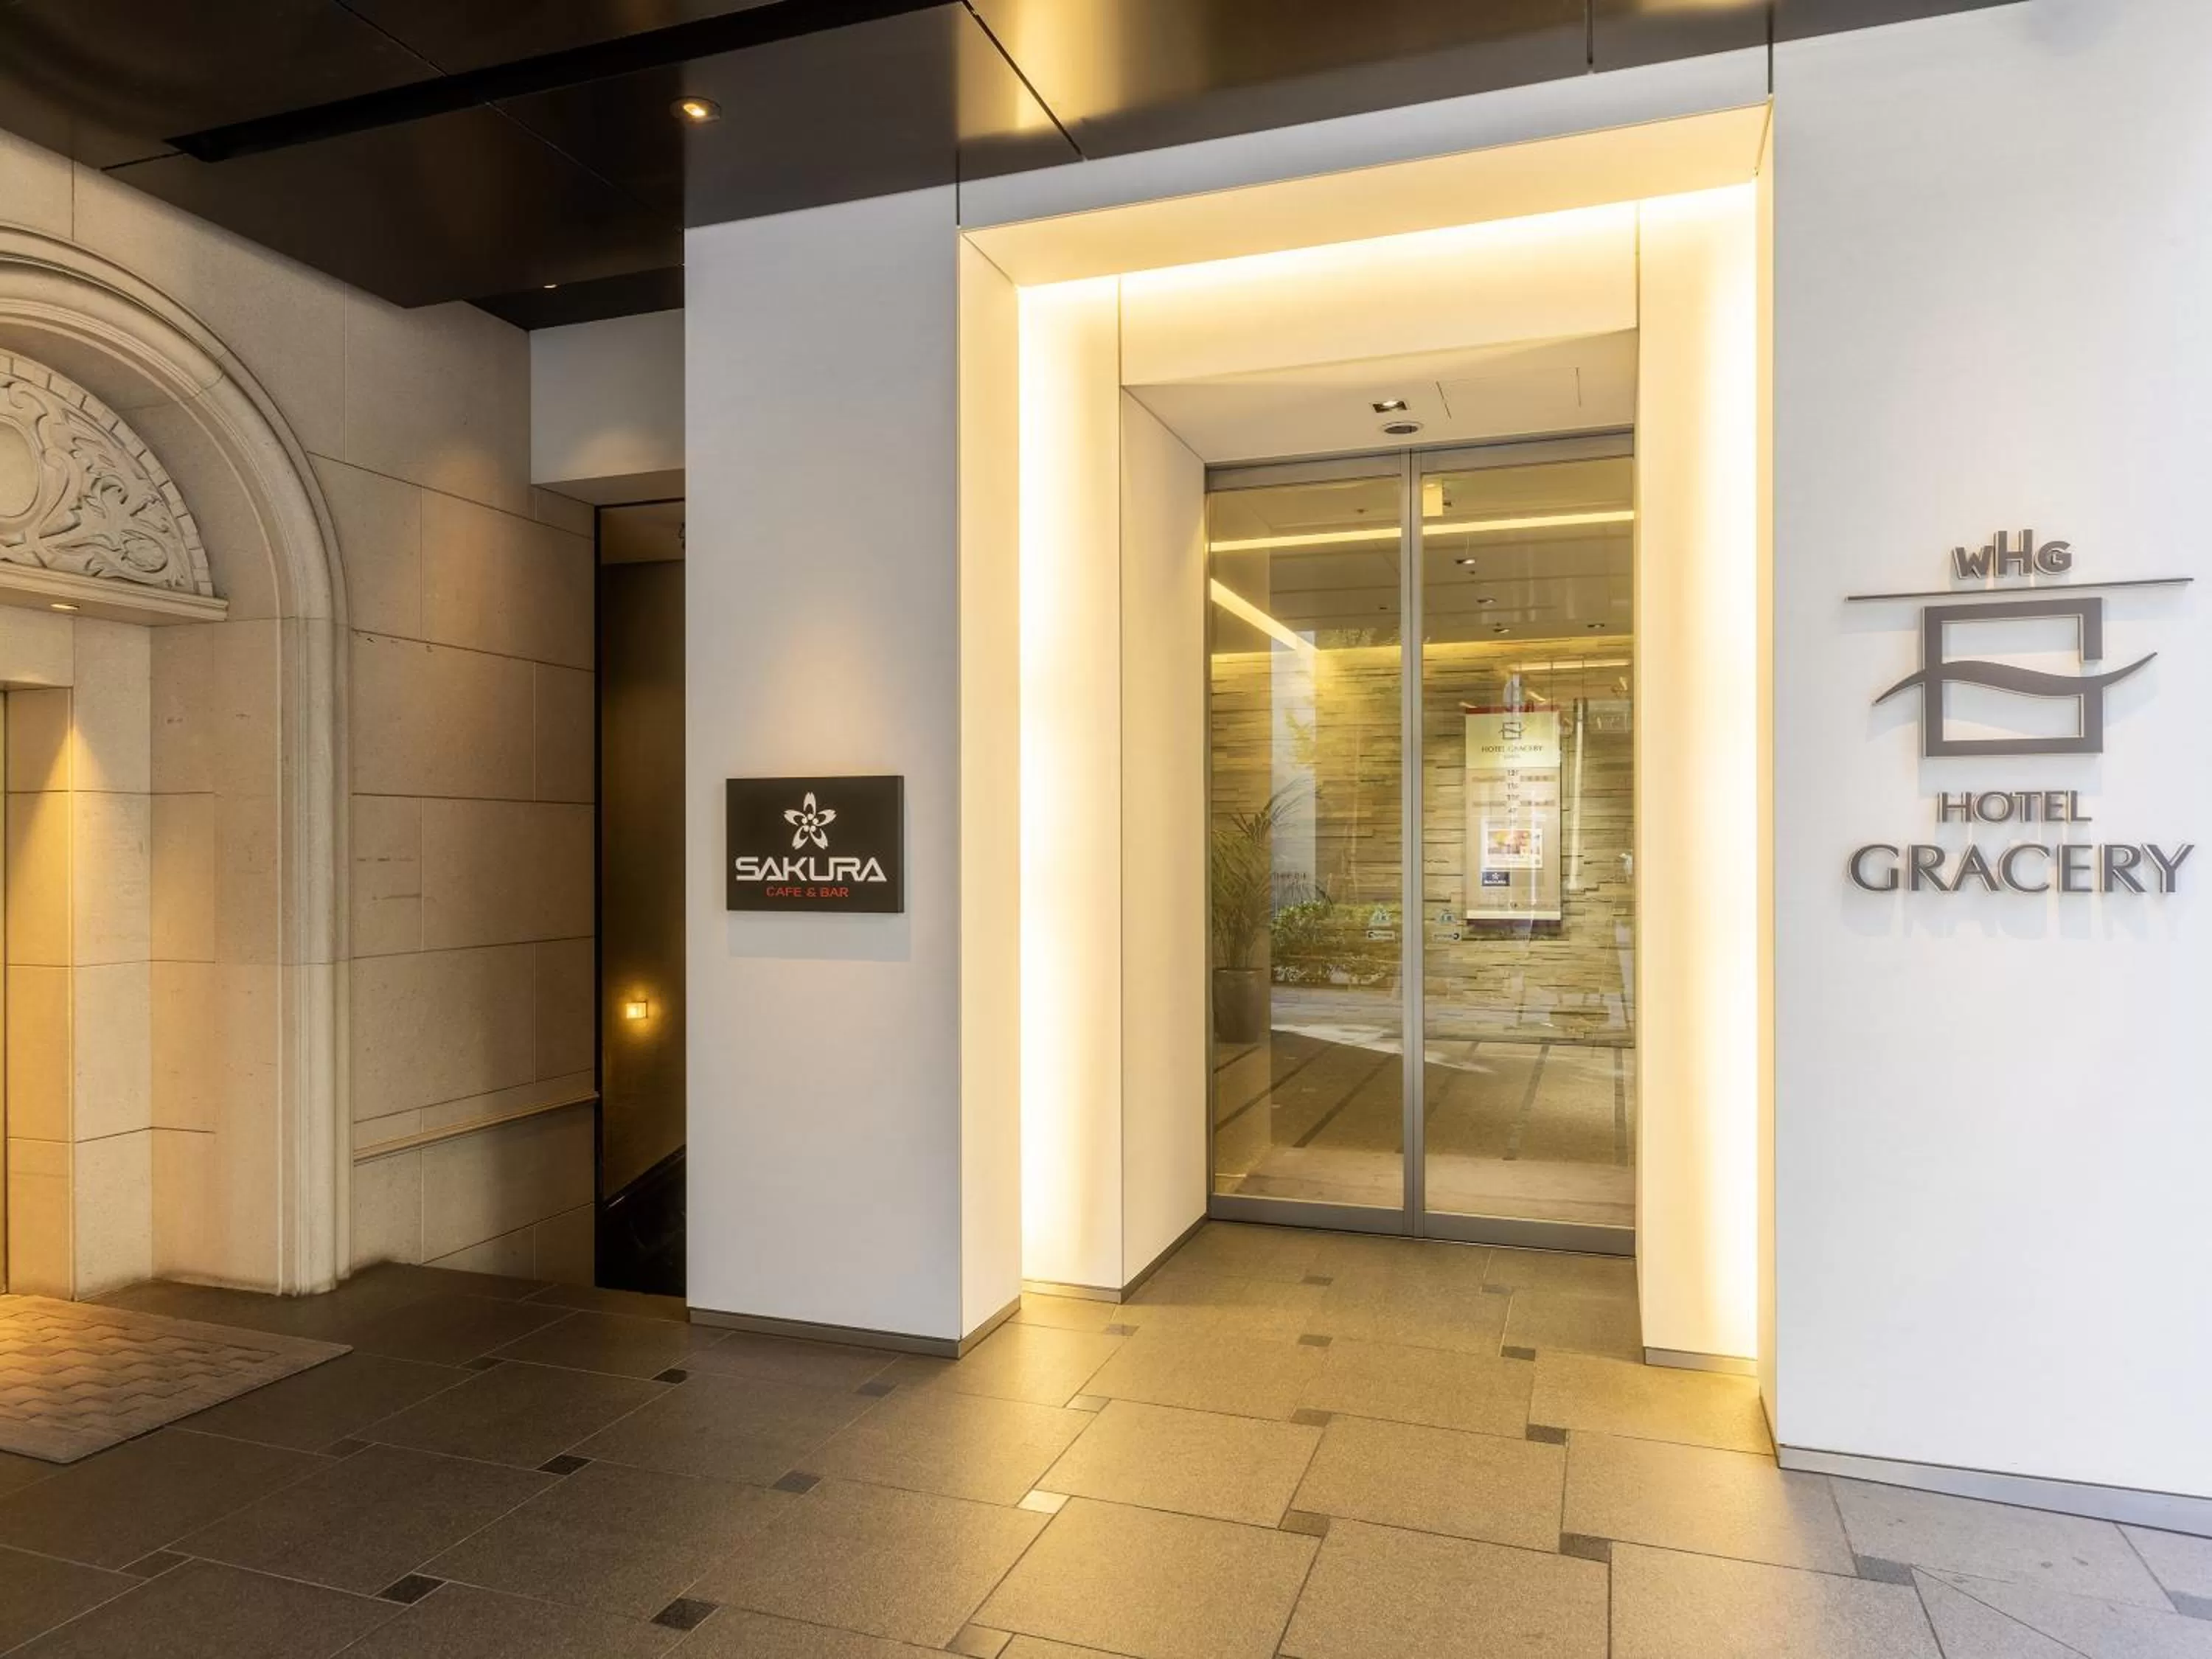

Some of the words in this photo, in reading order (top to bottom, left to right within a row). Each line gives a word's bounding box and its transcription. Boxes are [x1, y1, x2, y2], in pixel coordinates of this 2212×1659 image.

[1937, 790, 2093, 823] HOTEL
[735, 856, 887, 882] SAKURA
[1848, 843, 2195, 894] GRACERY
[766, 887, 802, 897] CAFE
[806, 887, 816, 897] &
[820, 887, 849, 897] BAR
